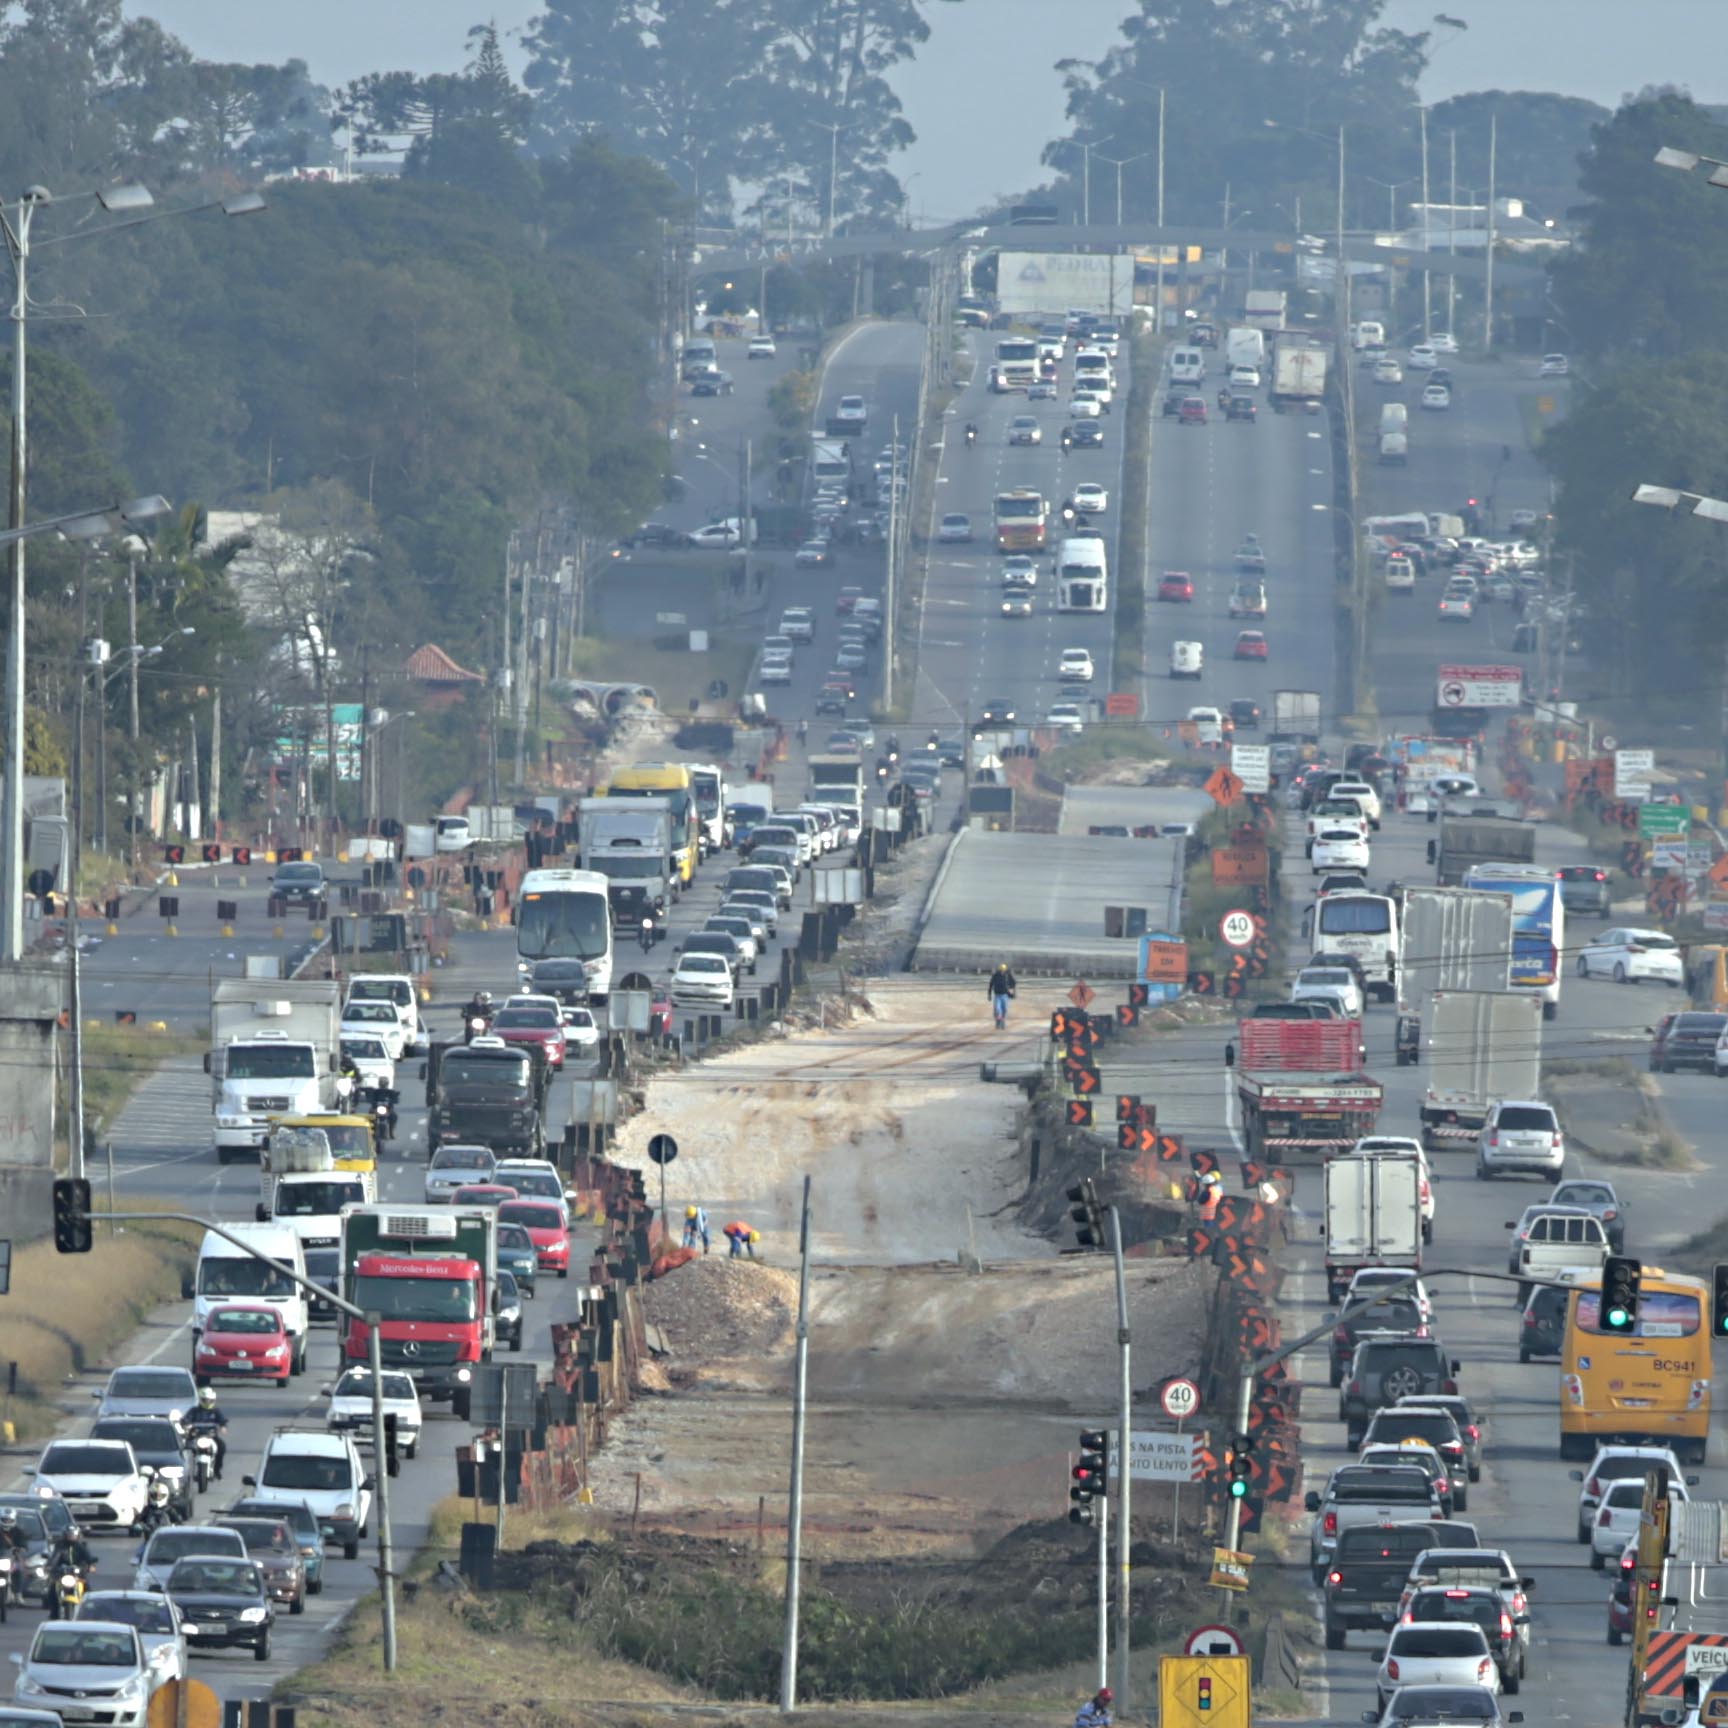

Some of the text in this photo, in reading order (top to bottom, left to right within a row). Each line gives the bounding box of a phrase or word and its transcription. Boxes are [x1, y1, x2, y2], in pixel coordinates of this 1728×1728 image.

[1227, 917, 1248, 932] 40
[380, 1264, 449, 1274] Mercedes-Benz
[1653, 1360, 1696, 1371] BC941
[1169, 1387, 1191, 1402] 40
[1139, 1442, 1154, 1452] NA
[1157, 1444, 1186, 1455] PISTA
[1153, 1459, 1188, 1471] LENTO
